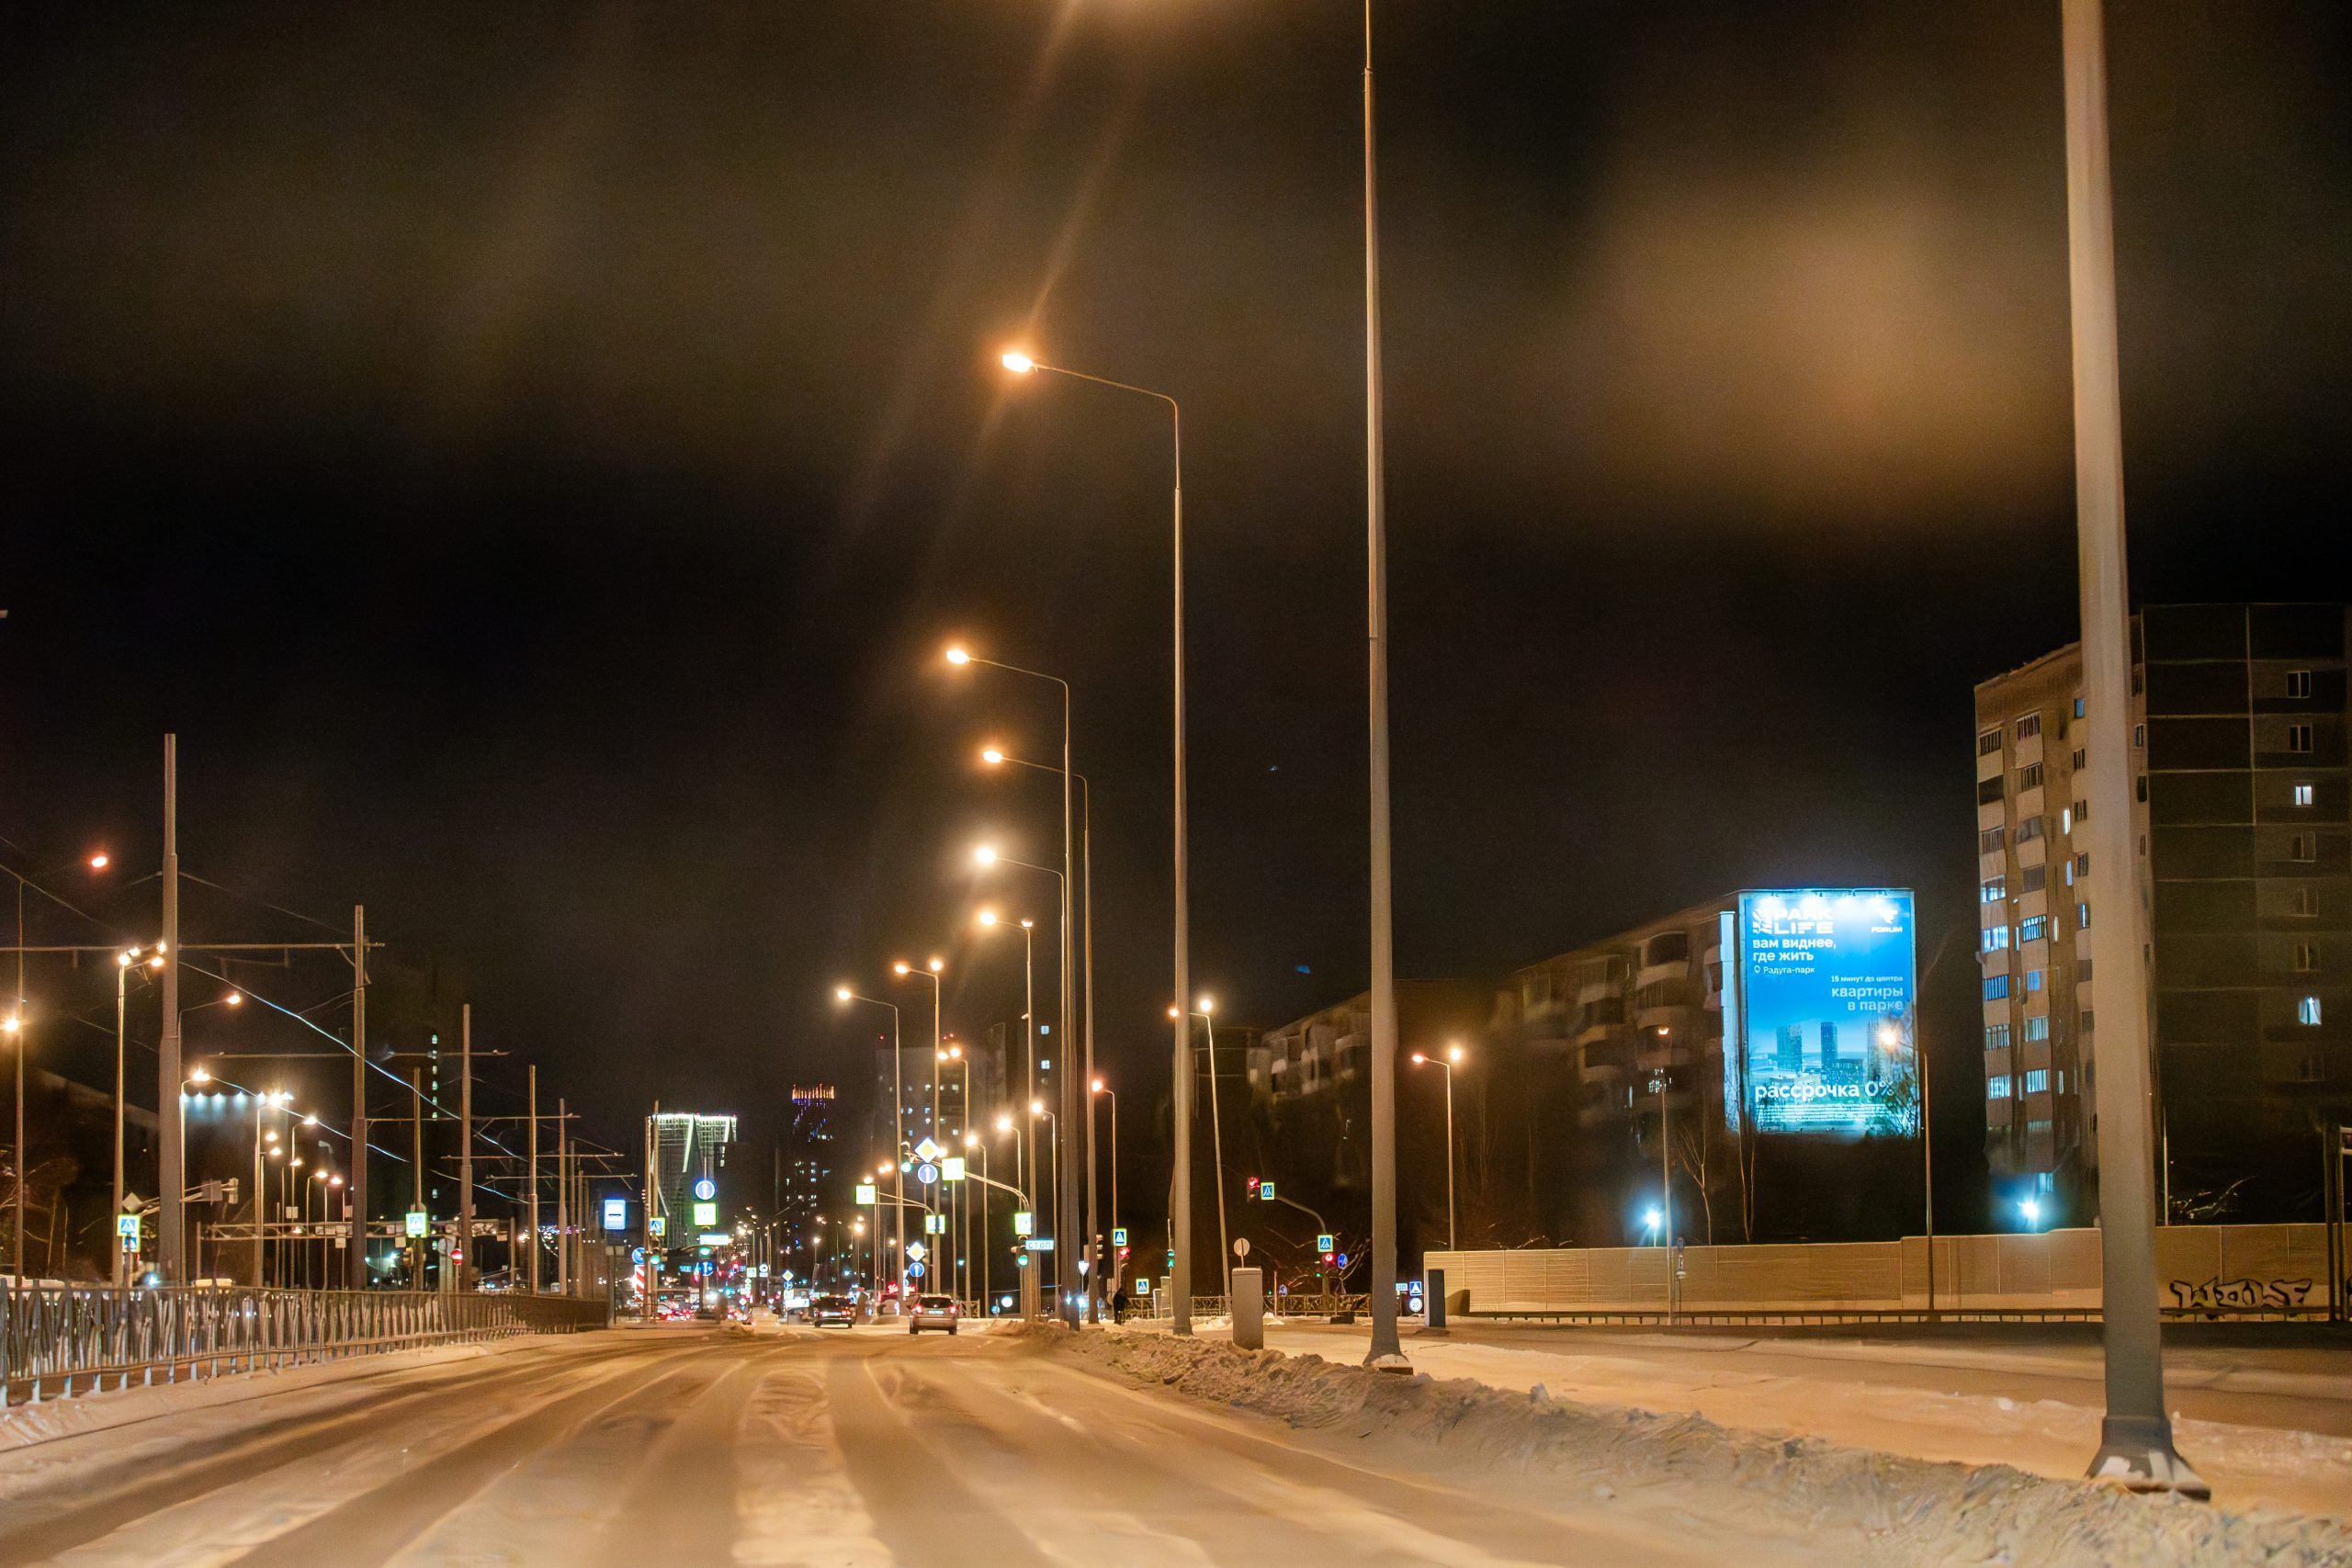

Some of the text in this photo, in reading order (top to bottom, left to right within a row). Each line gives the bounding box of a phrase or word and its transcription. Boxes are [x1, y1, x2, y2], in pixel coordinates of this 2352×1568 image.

[1774, 908, 1834, 920] PARK
[1774, 921, 1834, 934] LIFE
[1753, 938, 1837, 951] вам виднее,
[1753, 951, 1815, 964] где жить
[1763, 966, 1815, 975] Радуга-парк
[1831, 987, 1904, 1000] квартиры
[1848, 999, 1904, 1013] в парке
[1755, 1080, 1895, 1102] рассрочка 0%
